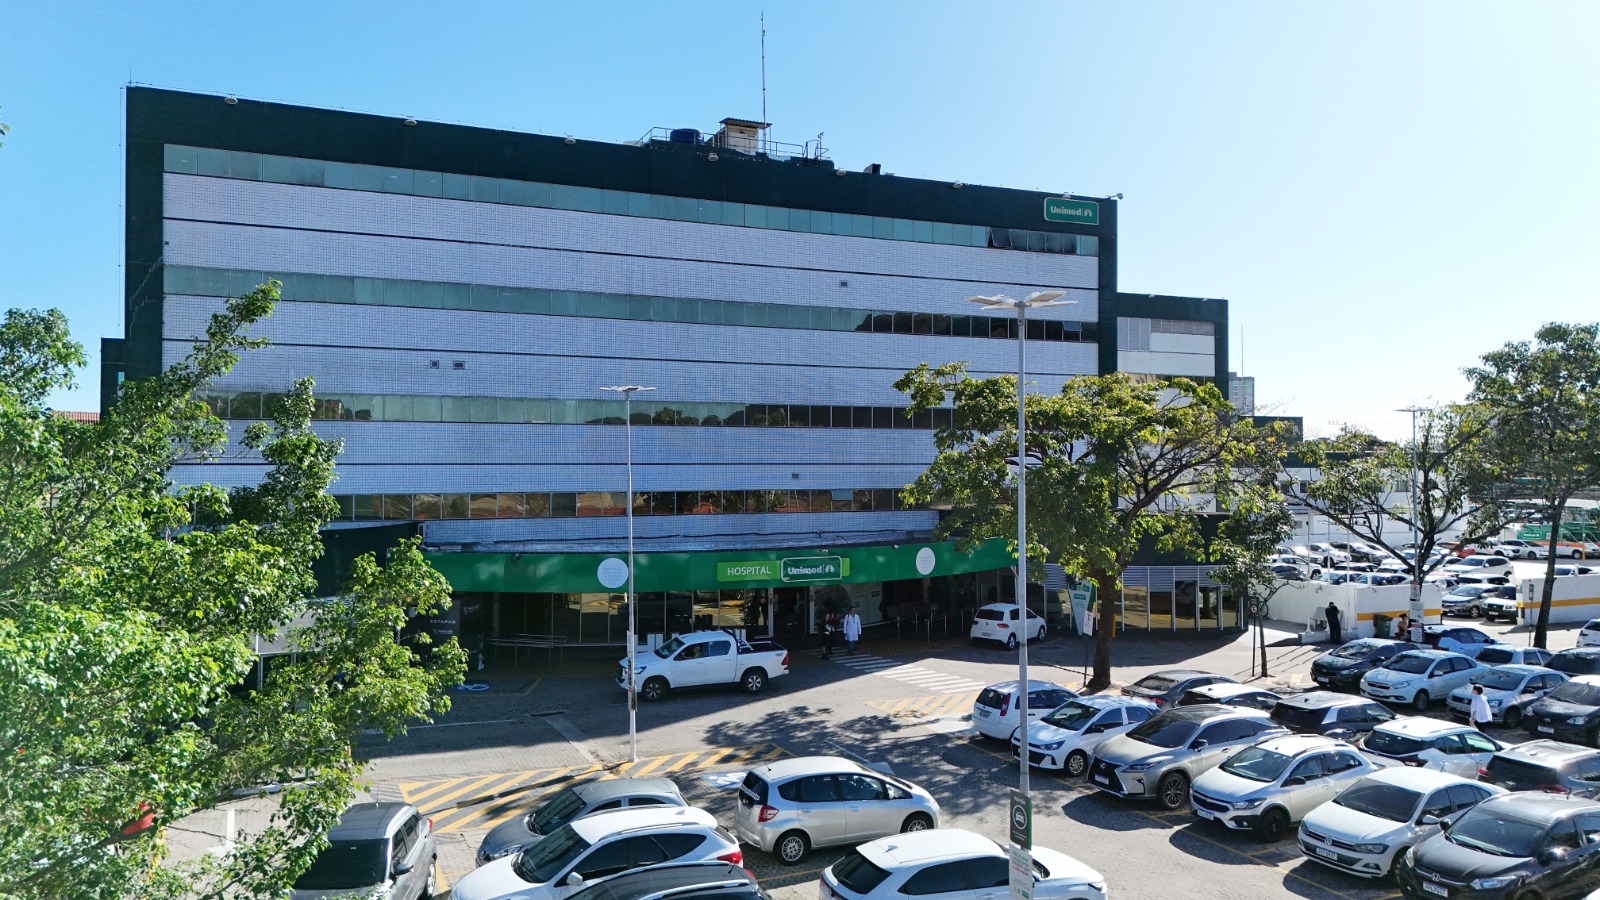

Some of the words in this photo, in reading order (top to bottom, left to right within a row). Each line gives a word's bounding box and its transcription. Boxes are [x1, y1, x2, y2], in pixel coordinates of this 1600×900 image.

[1050, 205, 1082, 216] Unimed
[727, 566, 772, 576] HOSPITAL
[787, 566, 823, 575] Unimed
